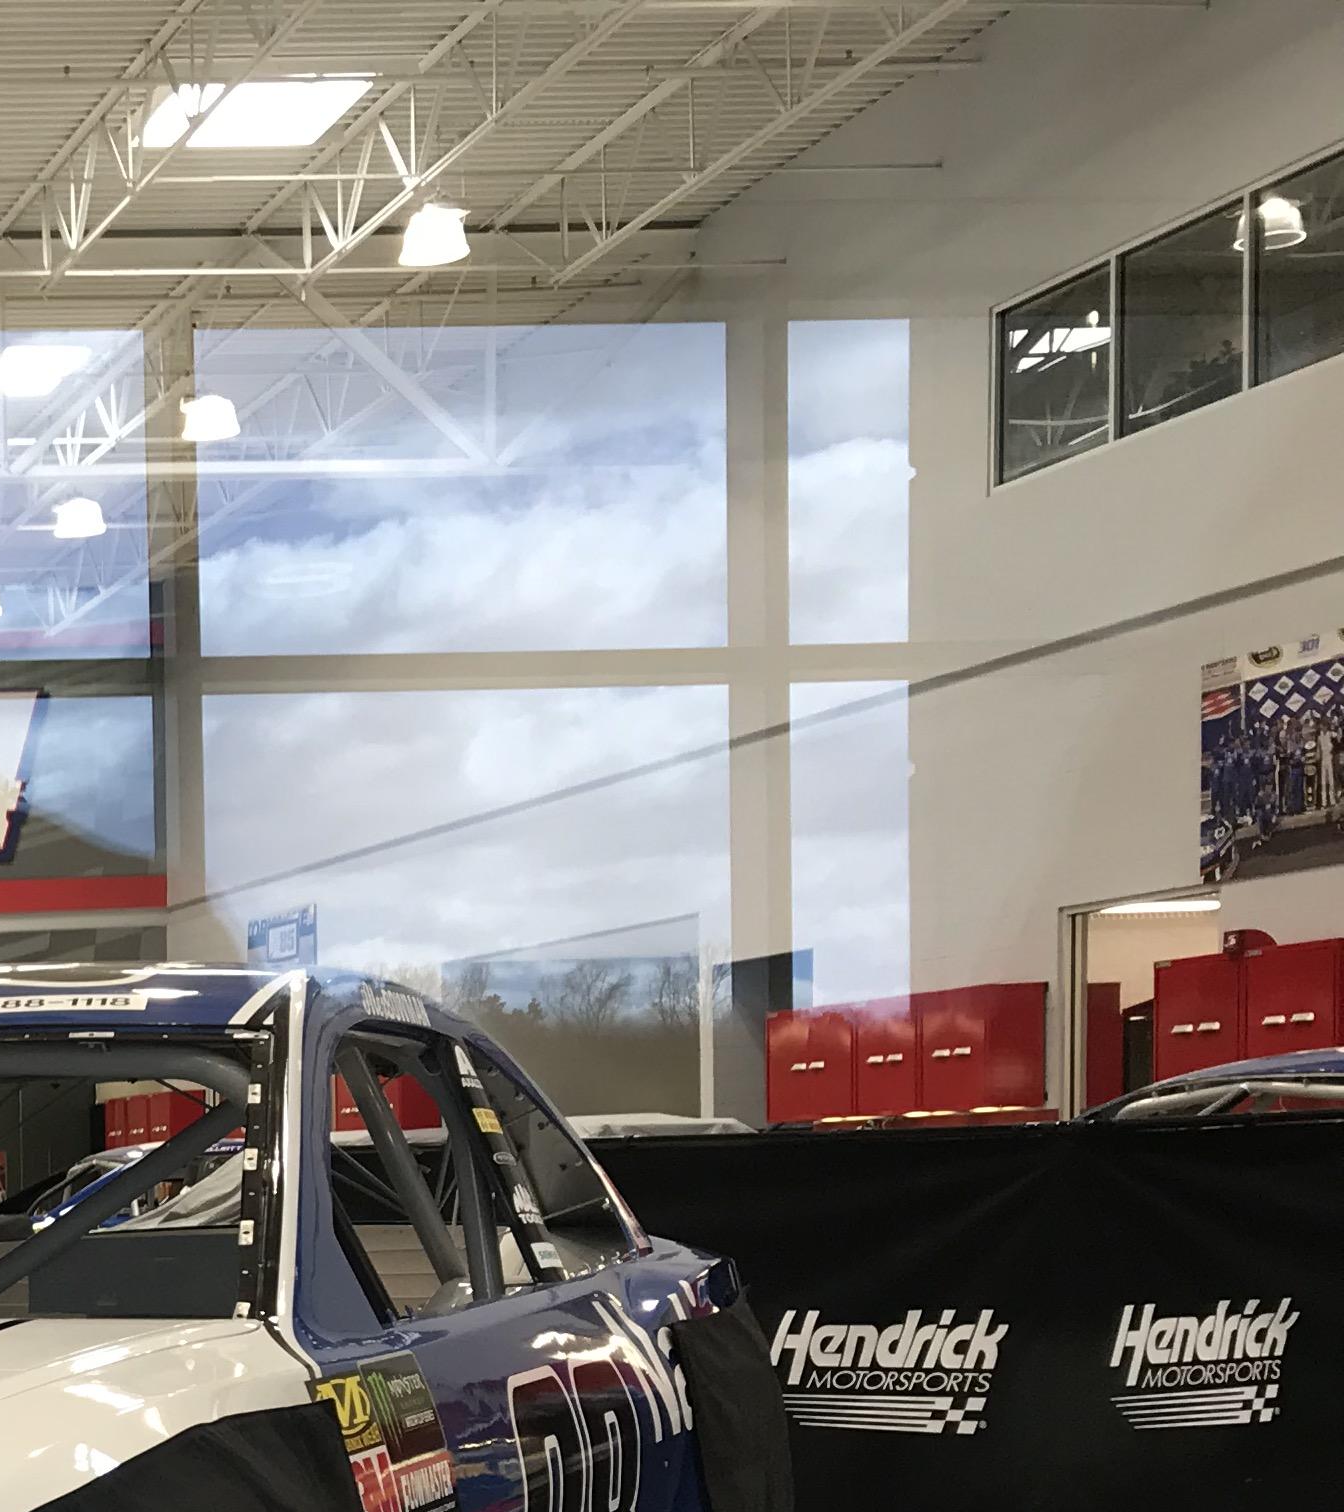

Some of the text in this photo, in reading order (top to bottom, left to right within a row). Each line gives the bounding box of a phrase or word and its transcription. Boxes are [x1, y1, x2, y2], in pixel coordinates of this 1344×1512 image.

[0, 997, 131, 1009] 88-1118
[770, 1309, 1009, 1385] Hendrick
[1110, 1297, 1300, 1387] Hendrick
[806, 1370, 992, 1393] MOTORSPORTS
[1142, 1360, 1281, 1389] MOTORSPORTS
